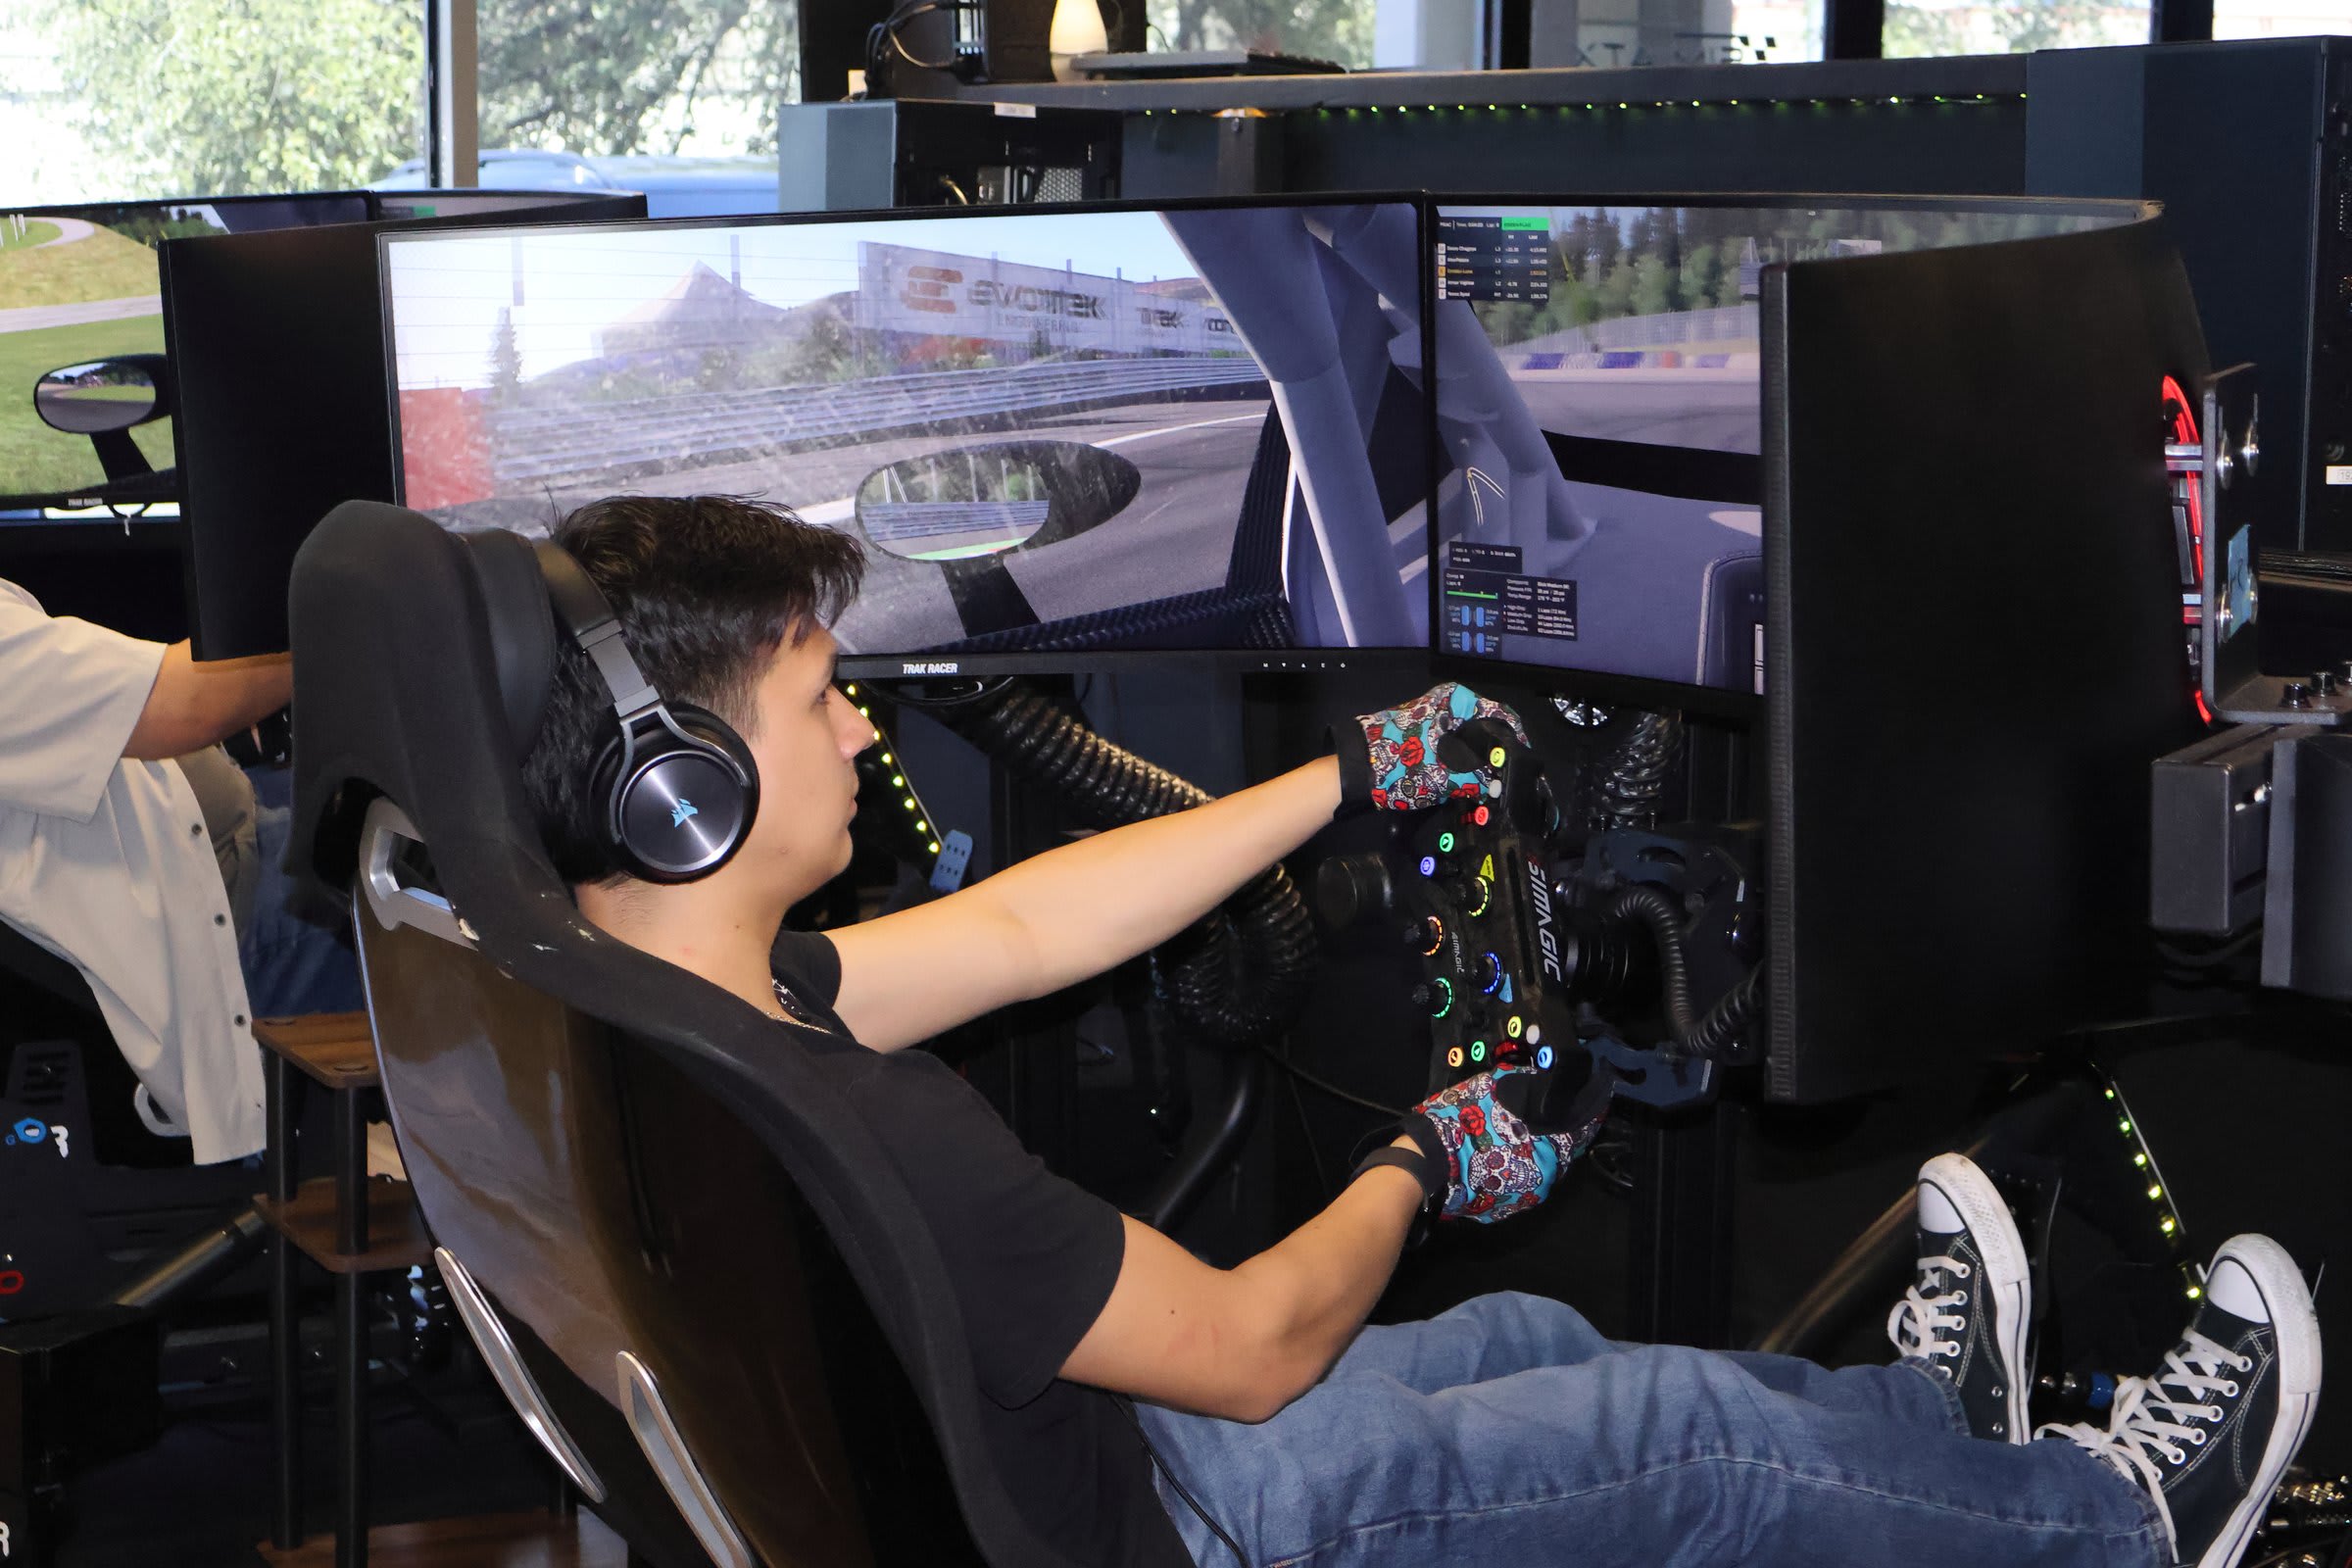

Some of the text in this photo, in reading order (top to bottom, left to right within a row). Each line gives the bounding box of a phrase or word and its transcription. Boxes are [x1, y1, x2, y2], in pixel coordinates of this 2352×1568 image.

[903, 662, 958, 674] TRAK RACER
[1528, 860, 1561, 982] SIMAGIC
